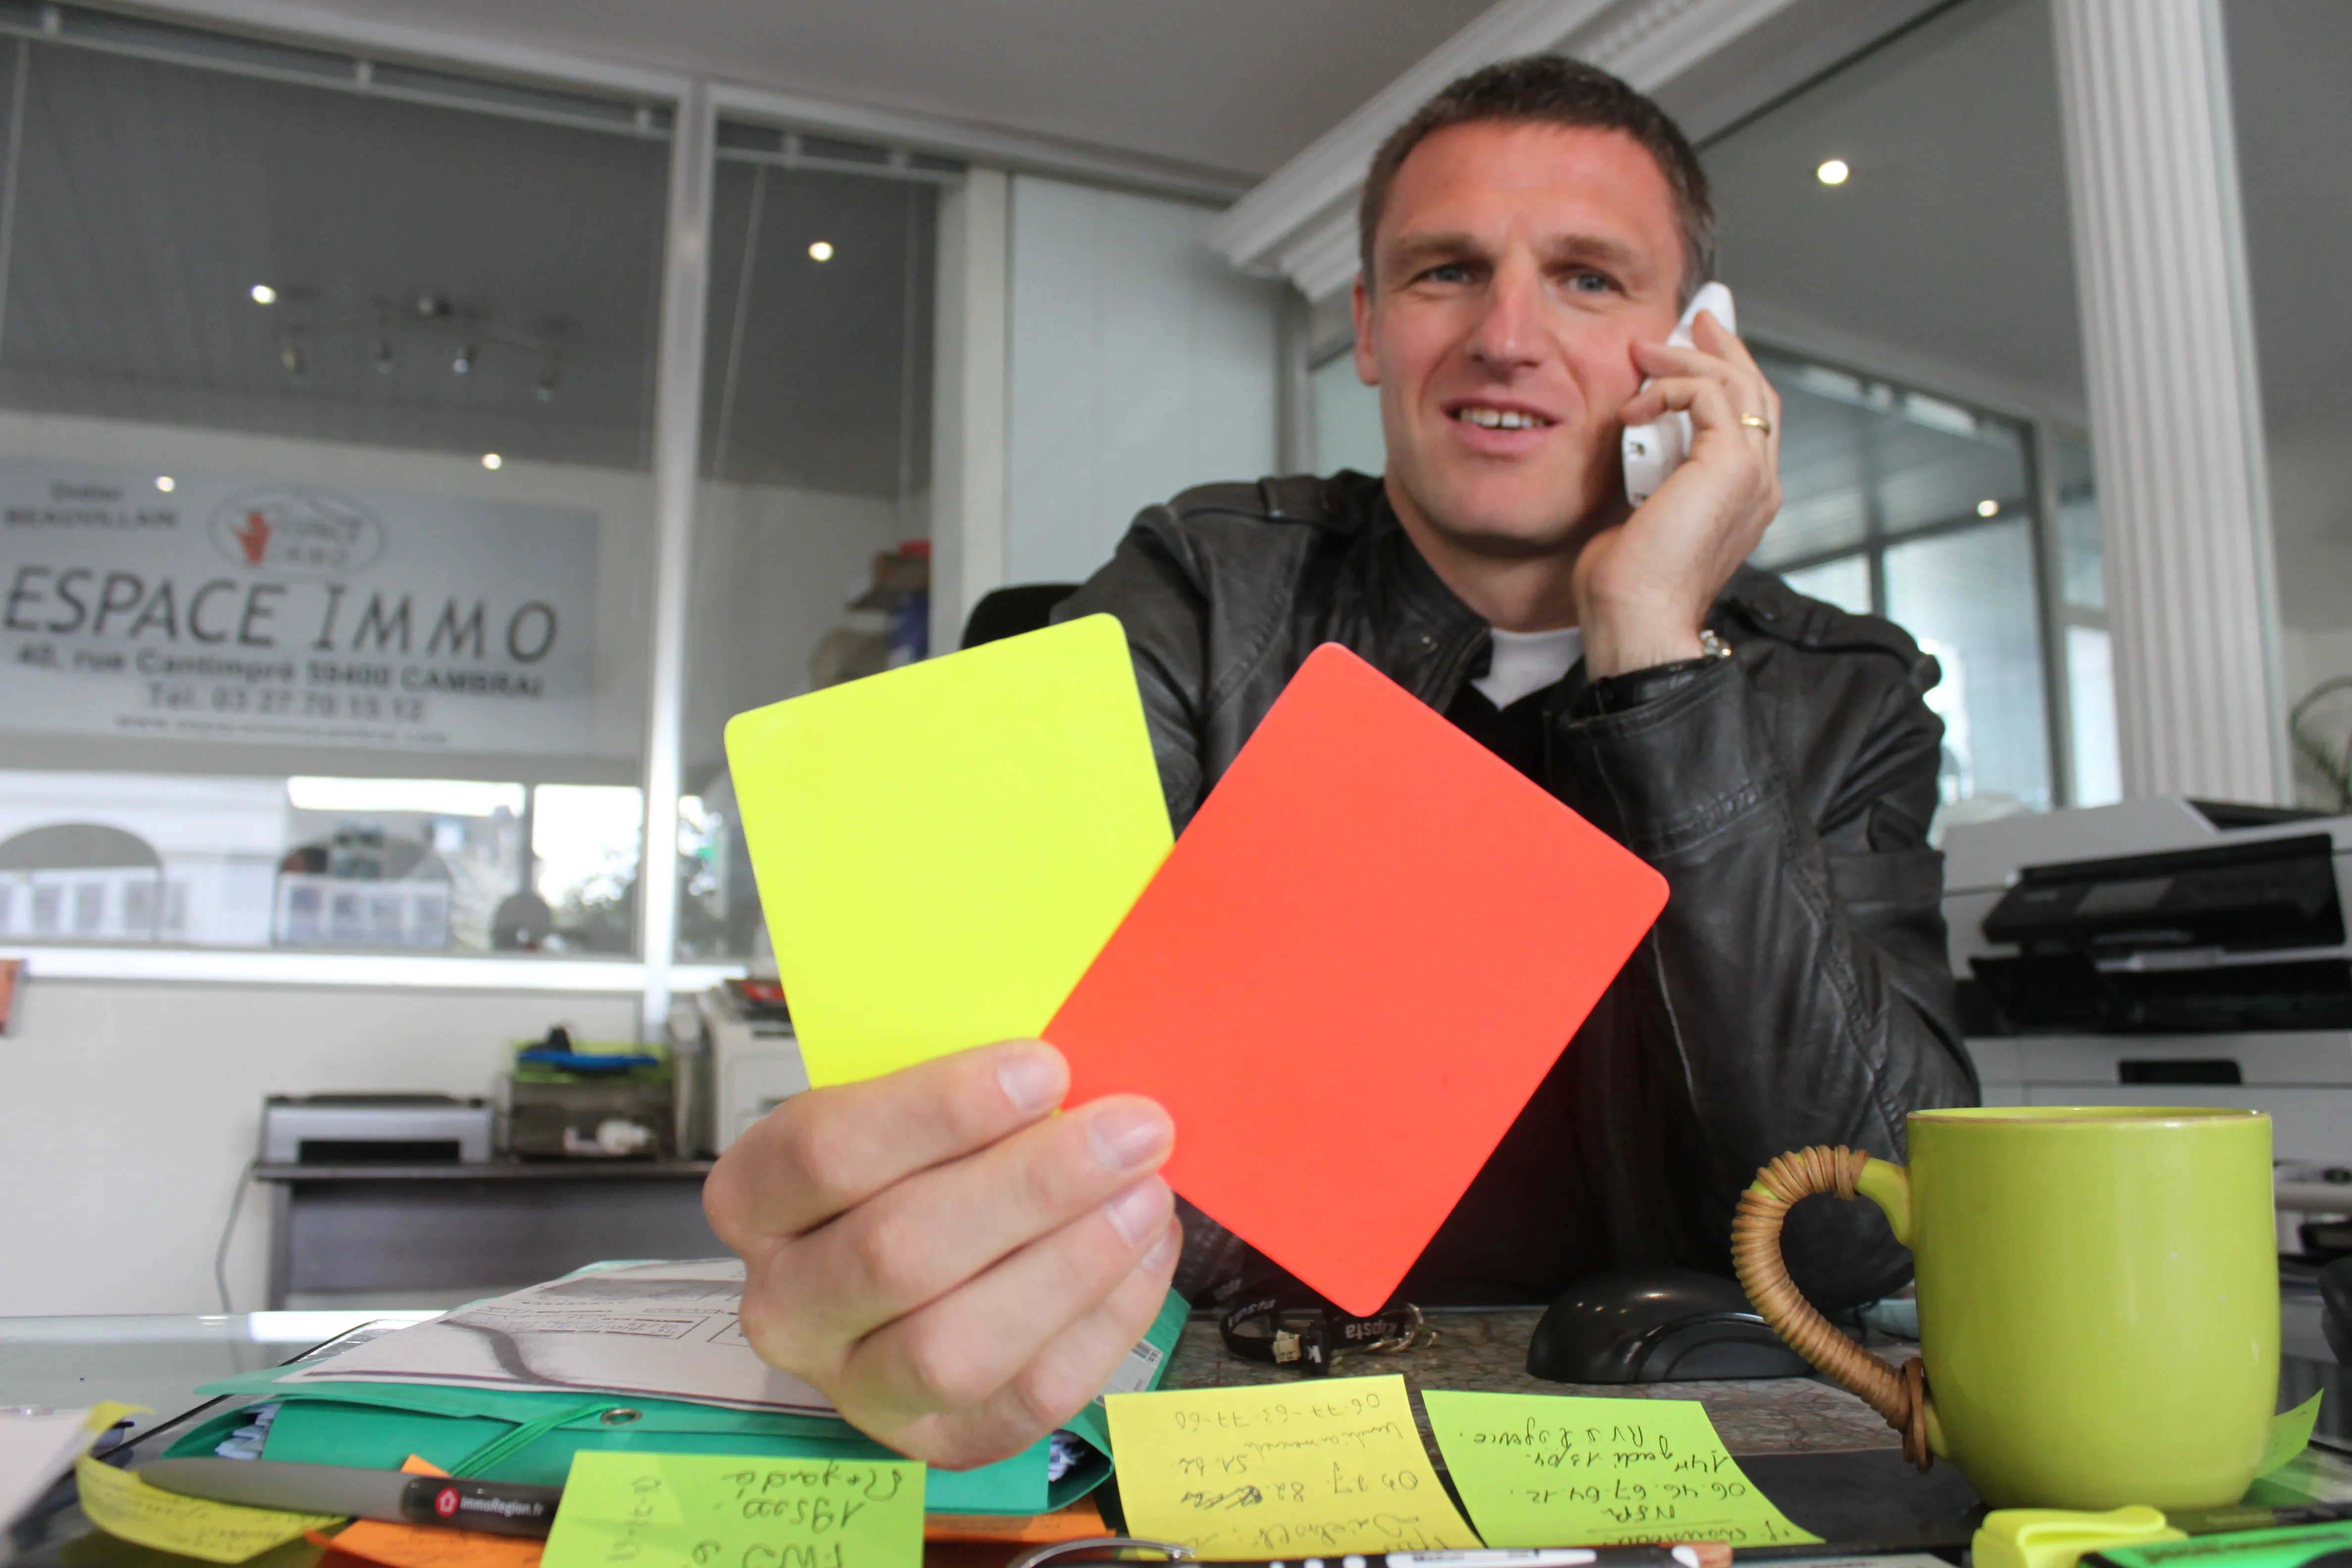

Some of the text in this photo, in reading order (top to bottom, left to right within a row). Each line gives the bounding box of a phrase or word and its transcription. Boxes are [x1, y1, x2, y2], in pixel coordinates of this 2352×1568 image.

[2, 565, 559, 664] ESPACE IMMO
[73, 648, 125, 672] rue
[399, 664, 543, 698] CAMBRAI
